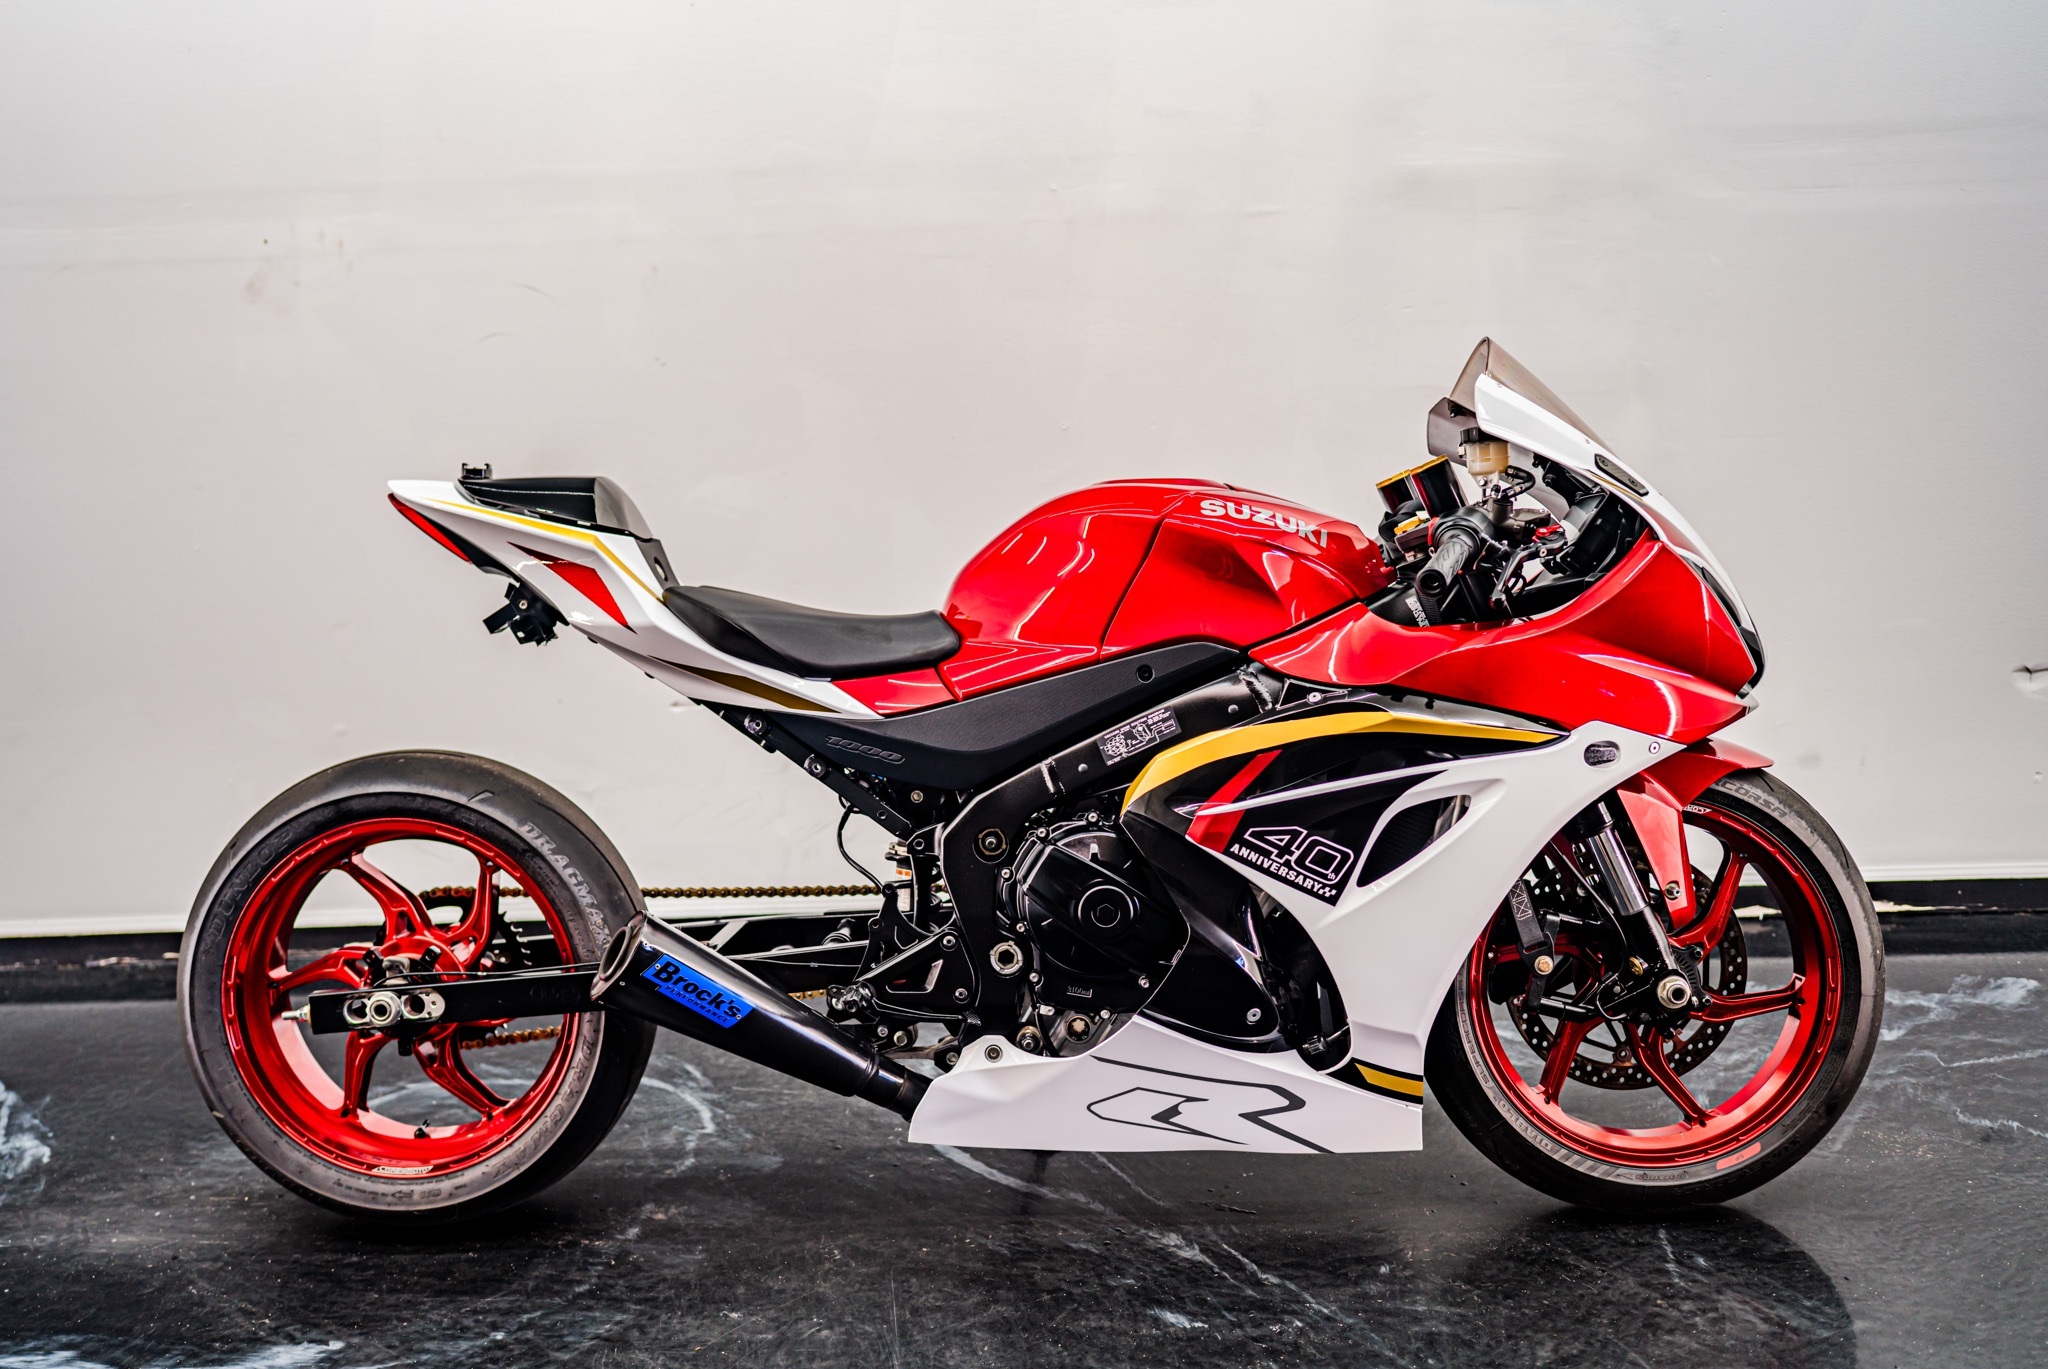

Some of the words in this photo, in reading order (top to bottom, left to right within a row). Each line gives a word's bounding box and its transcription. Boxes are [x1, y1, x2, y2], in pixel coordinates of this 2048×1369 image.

[1200, 499, 1328, 548] SUZUKI
[825, 735, 905, 765] 1000
[1230, 843, 1323, 894] ANNIVERSARY
[1243, 826, 1354, 884] 40
[207, 826, 294, 943] DUNLOP
[652, 960, 742, 1018] Brock's
[665, 985, 731, 1023] PERFORMANCE
[1458, 979, 1490, 1085] SUPERCORSA
[1498, 1100, 1552, 1152] DIABLO
